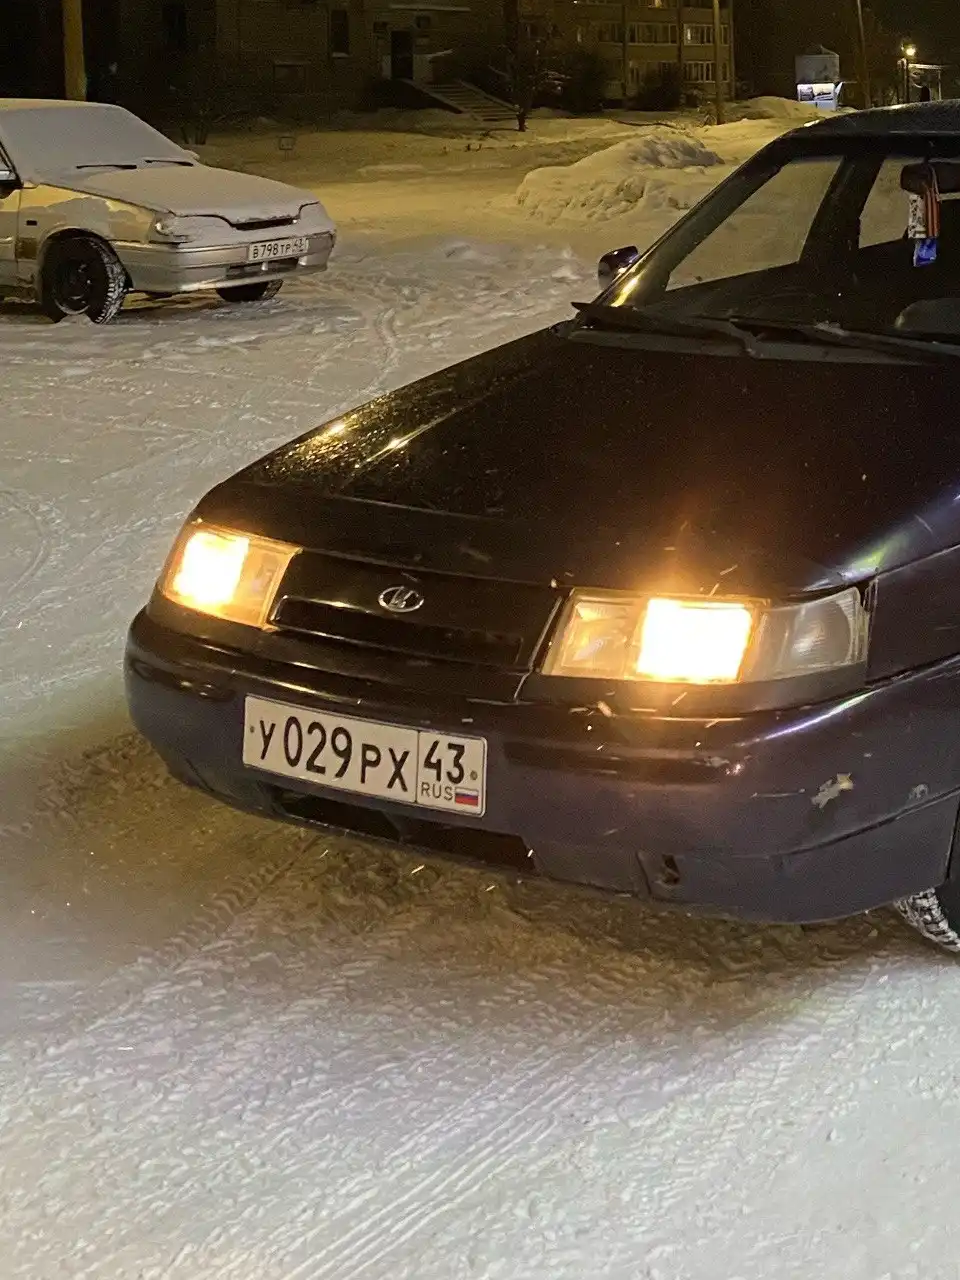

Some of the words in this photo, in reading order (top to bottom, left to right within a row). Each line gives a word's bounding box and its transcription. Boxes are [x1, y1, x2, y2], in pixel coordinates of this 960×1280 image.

[259, 716, 410, 792] У029РХ
[423, 740, 465, 784] 43
[420, 781, 453, 802] RUS
